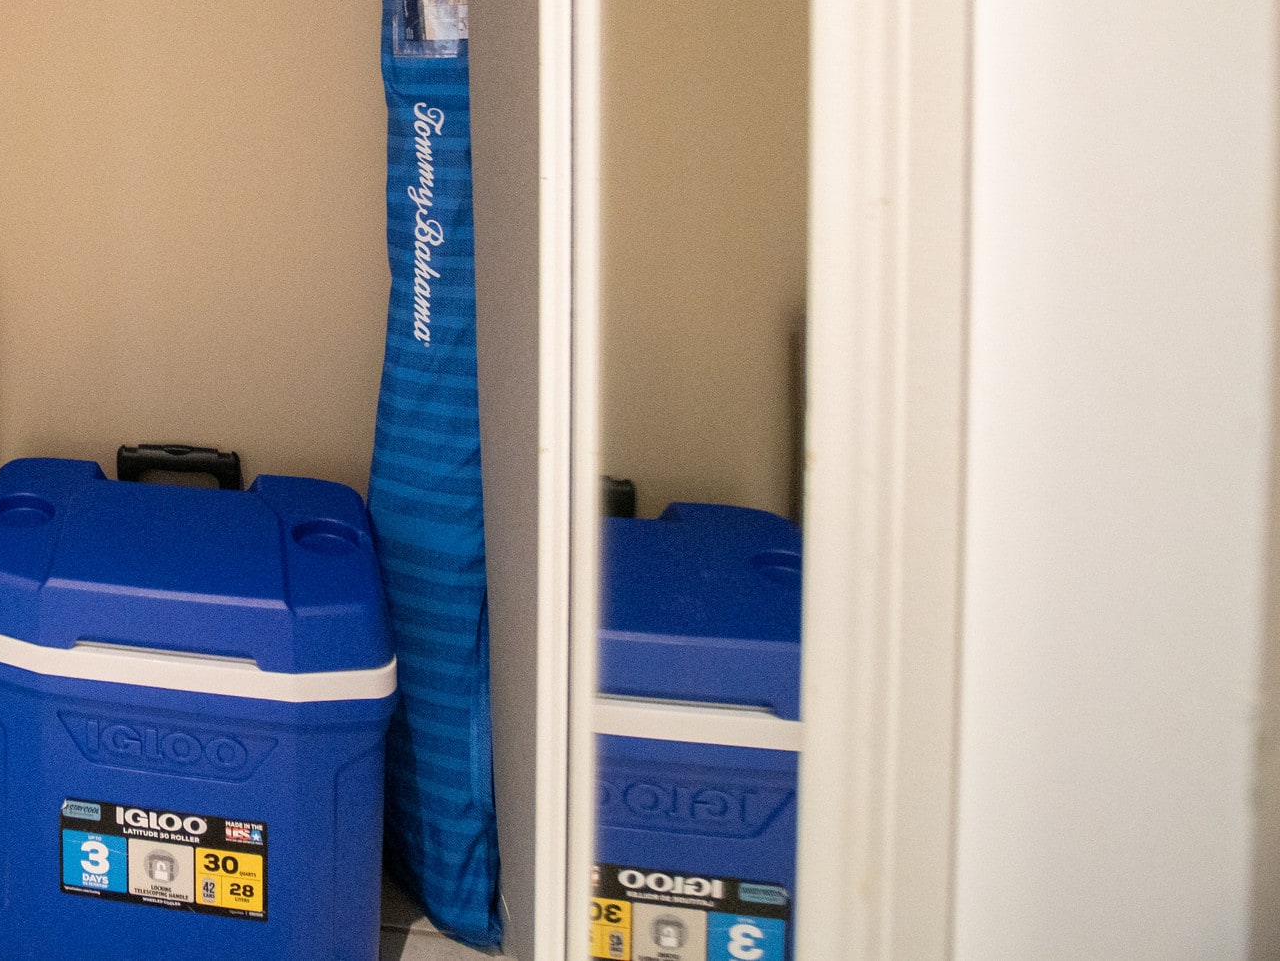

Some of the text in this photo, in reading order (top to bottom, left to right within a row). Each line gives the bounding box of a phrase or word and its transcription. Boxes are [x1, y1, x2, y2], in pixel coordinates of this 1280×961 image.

[407, 101, 445, 343] Tommy Bahama
[85, 719, 248, 768] IGLOO
[116, 806, 208, 835] IGLOO
[225, 820, 243, 828] MADE
[251, 823, 263, 832] THE
[122, 827, 200, 844] LATITUDE 30 ROLLER
[80, 840, 110, 875] 3
[203, 853, 239, 875] 30
[82, 873, 109, 885] DAYS
[134, 888, 168, 897] TELESCOPING
[202, 882, 216, 894] 42
[229, 883, 255, 898] 28
